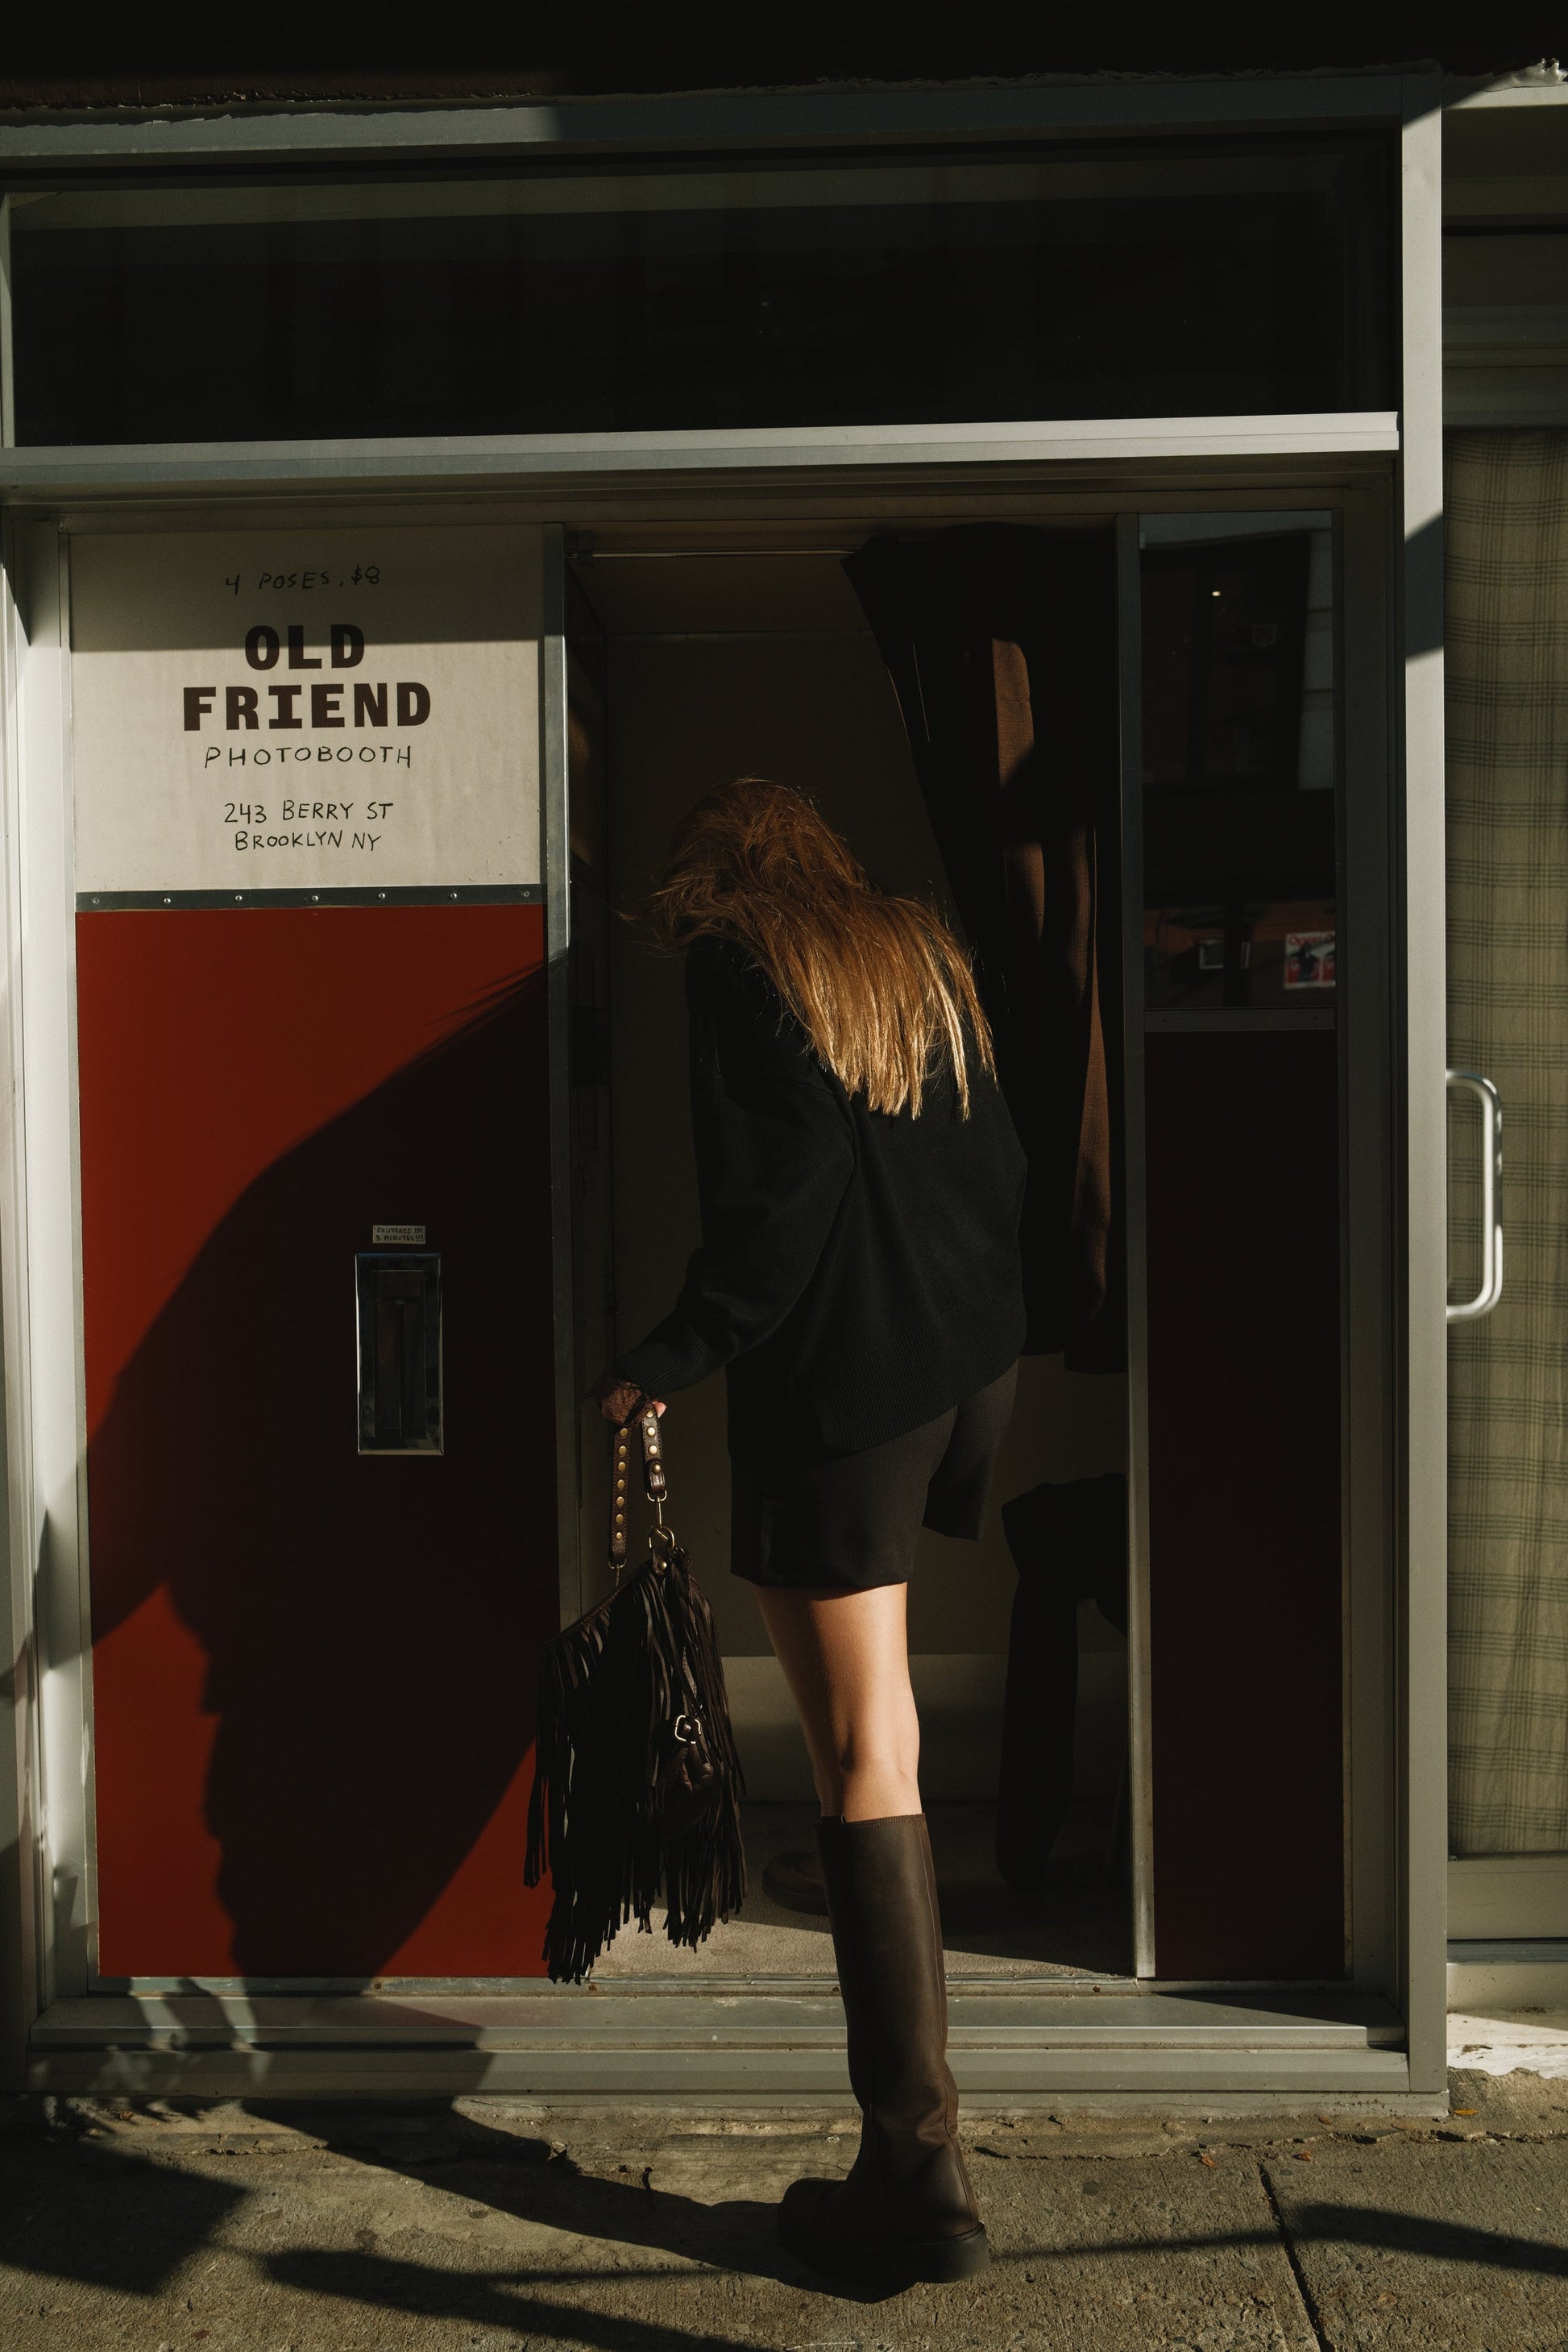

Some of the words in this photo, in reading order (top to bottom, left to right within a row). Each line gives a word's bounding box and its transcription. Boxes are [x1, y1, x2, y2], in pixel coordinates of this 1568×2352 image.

[225, 575, 241, 596] 4
[351, 566, 381, 587] $8
[244, 624, 365, 670] OLD
[183, 682, 431, 731] FRIEND
[205, 746, 412, 769] PHOTOBOOTH
[224, 803, 268, 823] 243
[282, 800, 354, 821] BERRY
[367, 803, 394, 820] ST
[235, 831, 344, 852] BROOKLYN
[352, 833, 381, 852] NY
